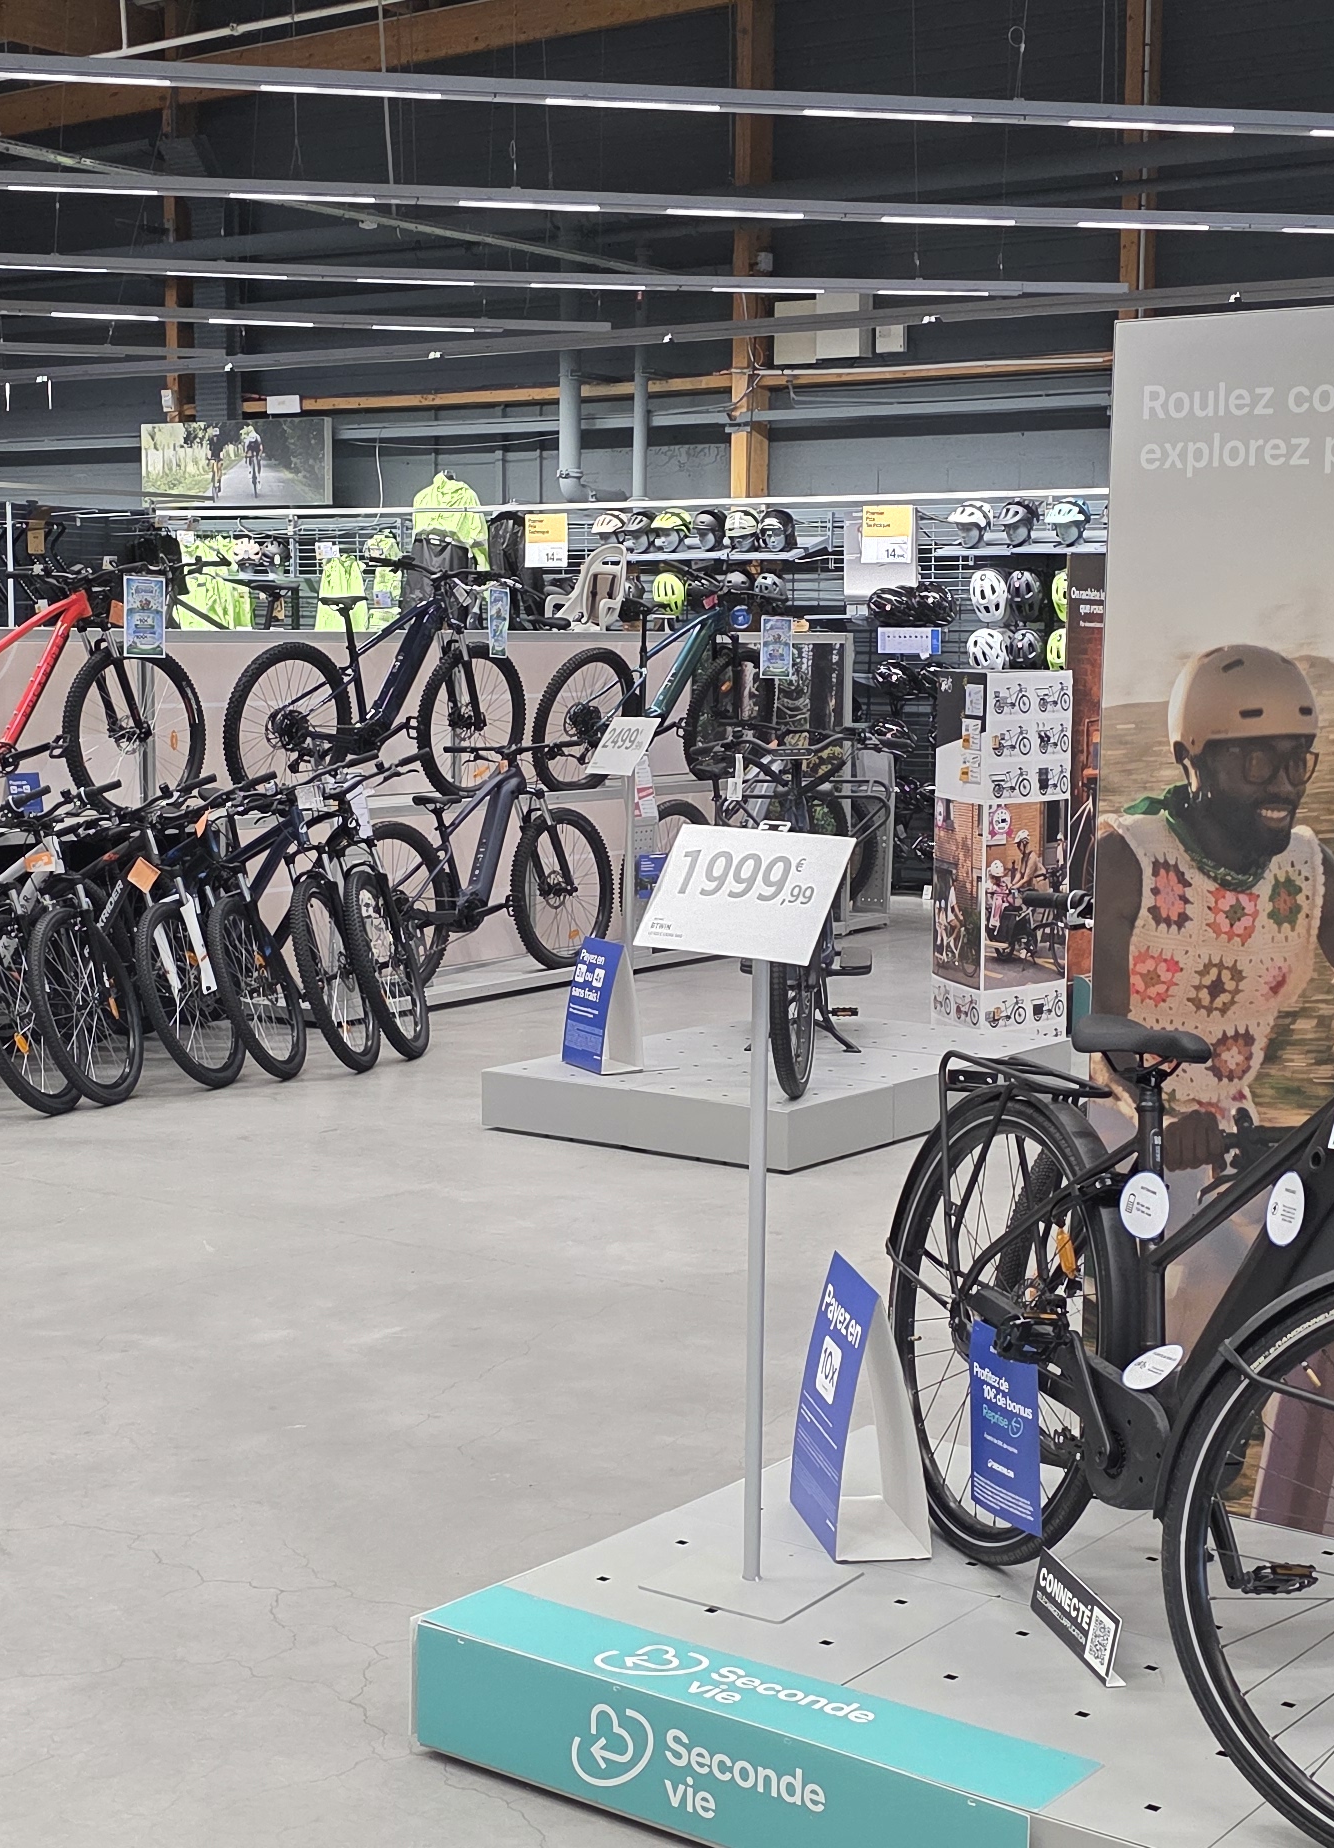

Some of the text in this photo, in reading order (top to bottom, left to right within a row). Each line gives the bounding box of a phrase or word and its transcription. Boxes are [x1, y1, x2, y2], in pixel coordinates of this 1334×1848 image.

[1142, 381, 1275, 420] Roulez
[1140, 432, 1311, 478] explorez
[600, 727, 640, 751] 2499
[676, 849, 793, 902] 1999
[579, 948, 605, 966] Payez en
[571, 986, 585, 998] sans
[584, 972, 594, 982] ou
[821, 1283, 862, 1349] Payez en
[821, 1346, 838, 1388] 10x
[973, 1361, 1009, 1393] Profitez de
[982, 1384, 1033, 1420] 10€ de bonus
[982, 1403, 1009, 1429] Reprise
[1039, 1567, 1092, 1632] CONNECTÉ
[687, 1680, 742, 1705] vie
[710, 1666, 876, 1724] Seconde
[664, 1728, 826, 1813] Seconde
[664, 1776, 717, 1820] vie
